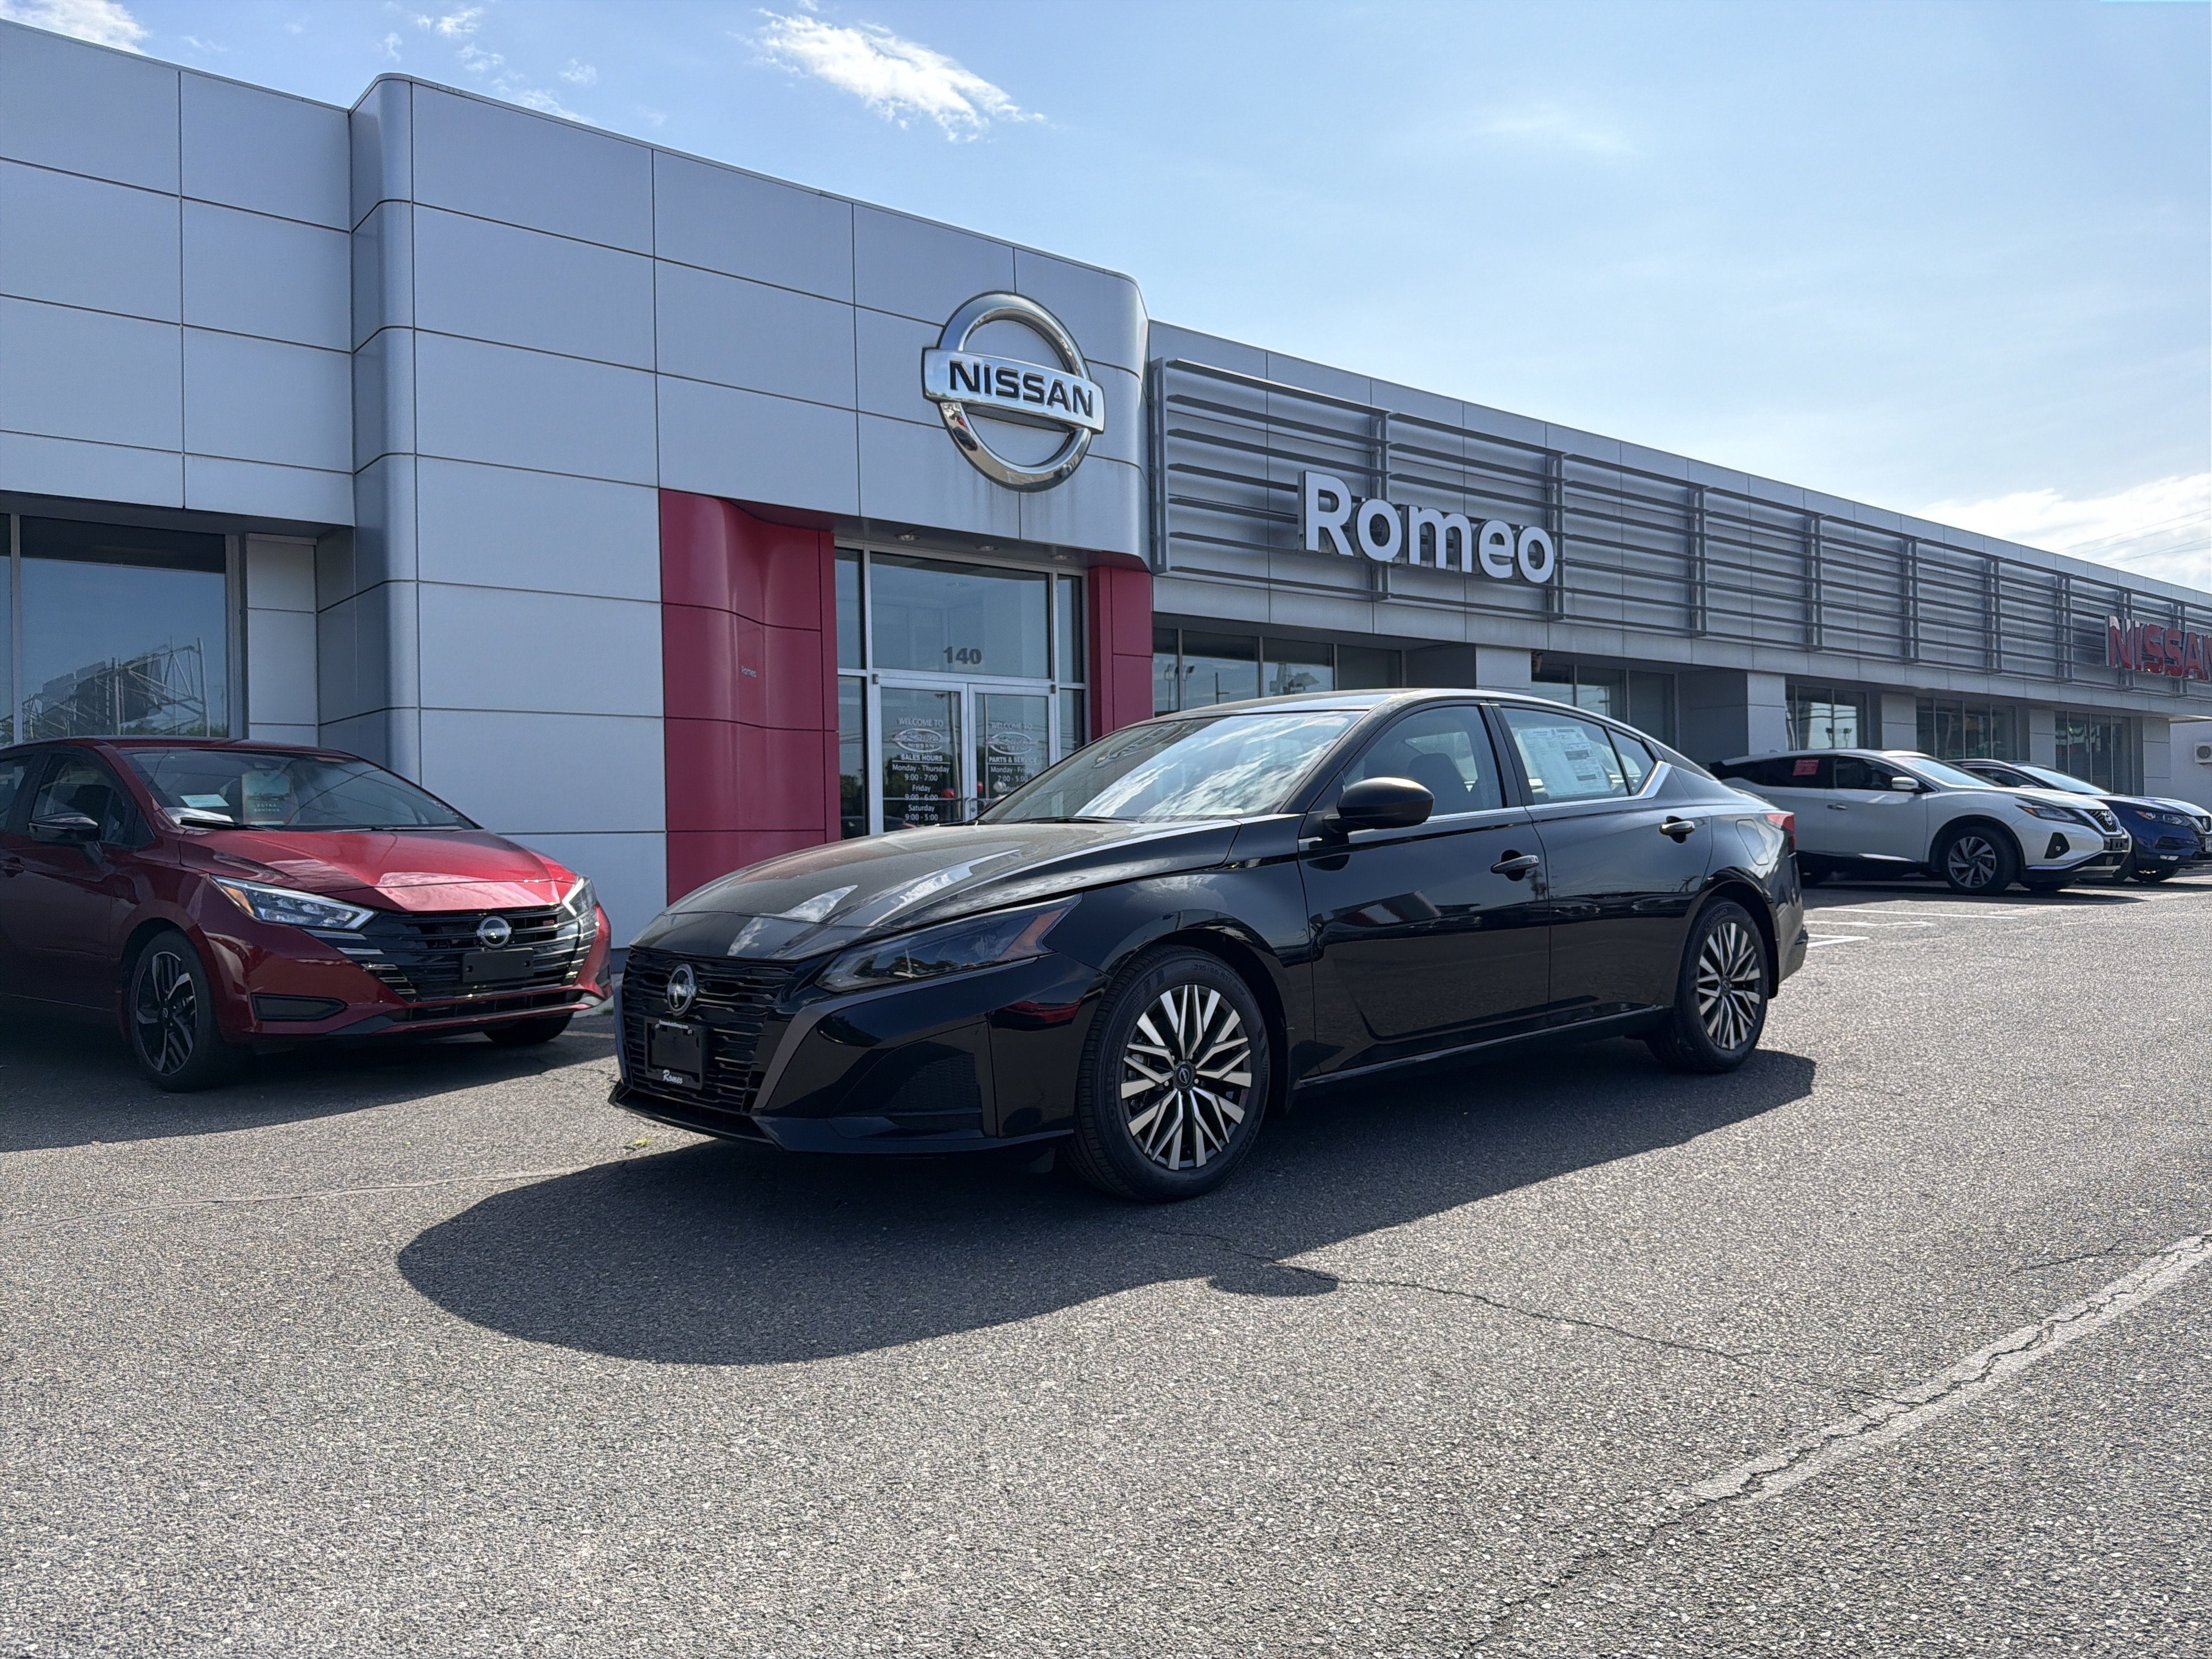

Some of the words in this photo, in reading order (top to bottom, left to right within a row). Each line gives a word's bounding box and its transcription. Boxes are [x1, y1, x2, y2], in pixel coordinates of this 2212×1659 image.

[949, 360, 1093, 419] NISSAN
[1300, 470, 1555, 584] Romeo
[943, 646, 982, 664] 140
[898, 718, 933, 726] WELCOME
[934, 719, 944, 727] TO
[892, 764, 917, 773] Monday
[922, 764, 950, 774] Thursday
[990, 766, 1013, 774] Monday
[905, 773, 919, 781] 9:00
[924, 774, 938, 782] 7:00
[912, 784, 932, 793] Friday
[908, 804, 935, 812] Saturday
[662, 1069, 684, 1085] Romeo
